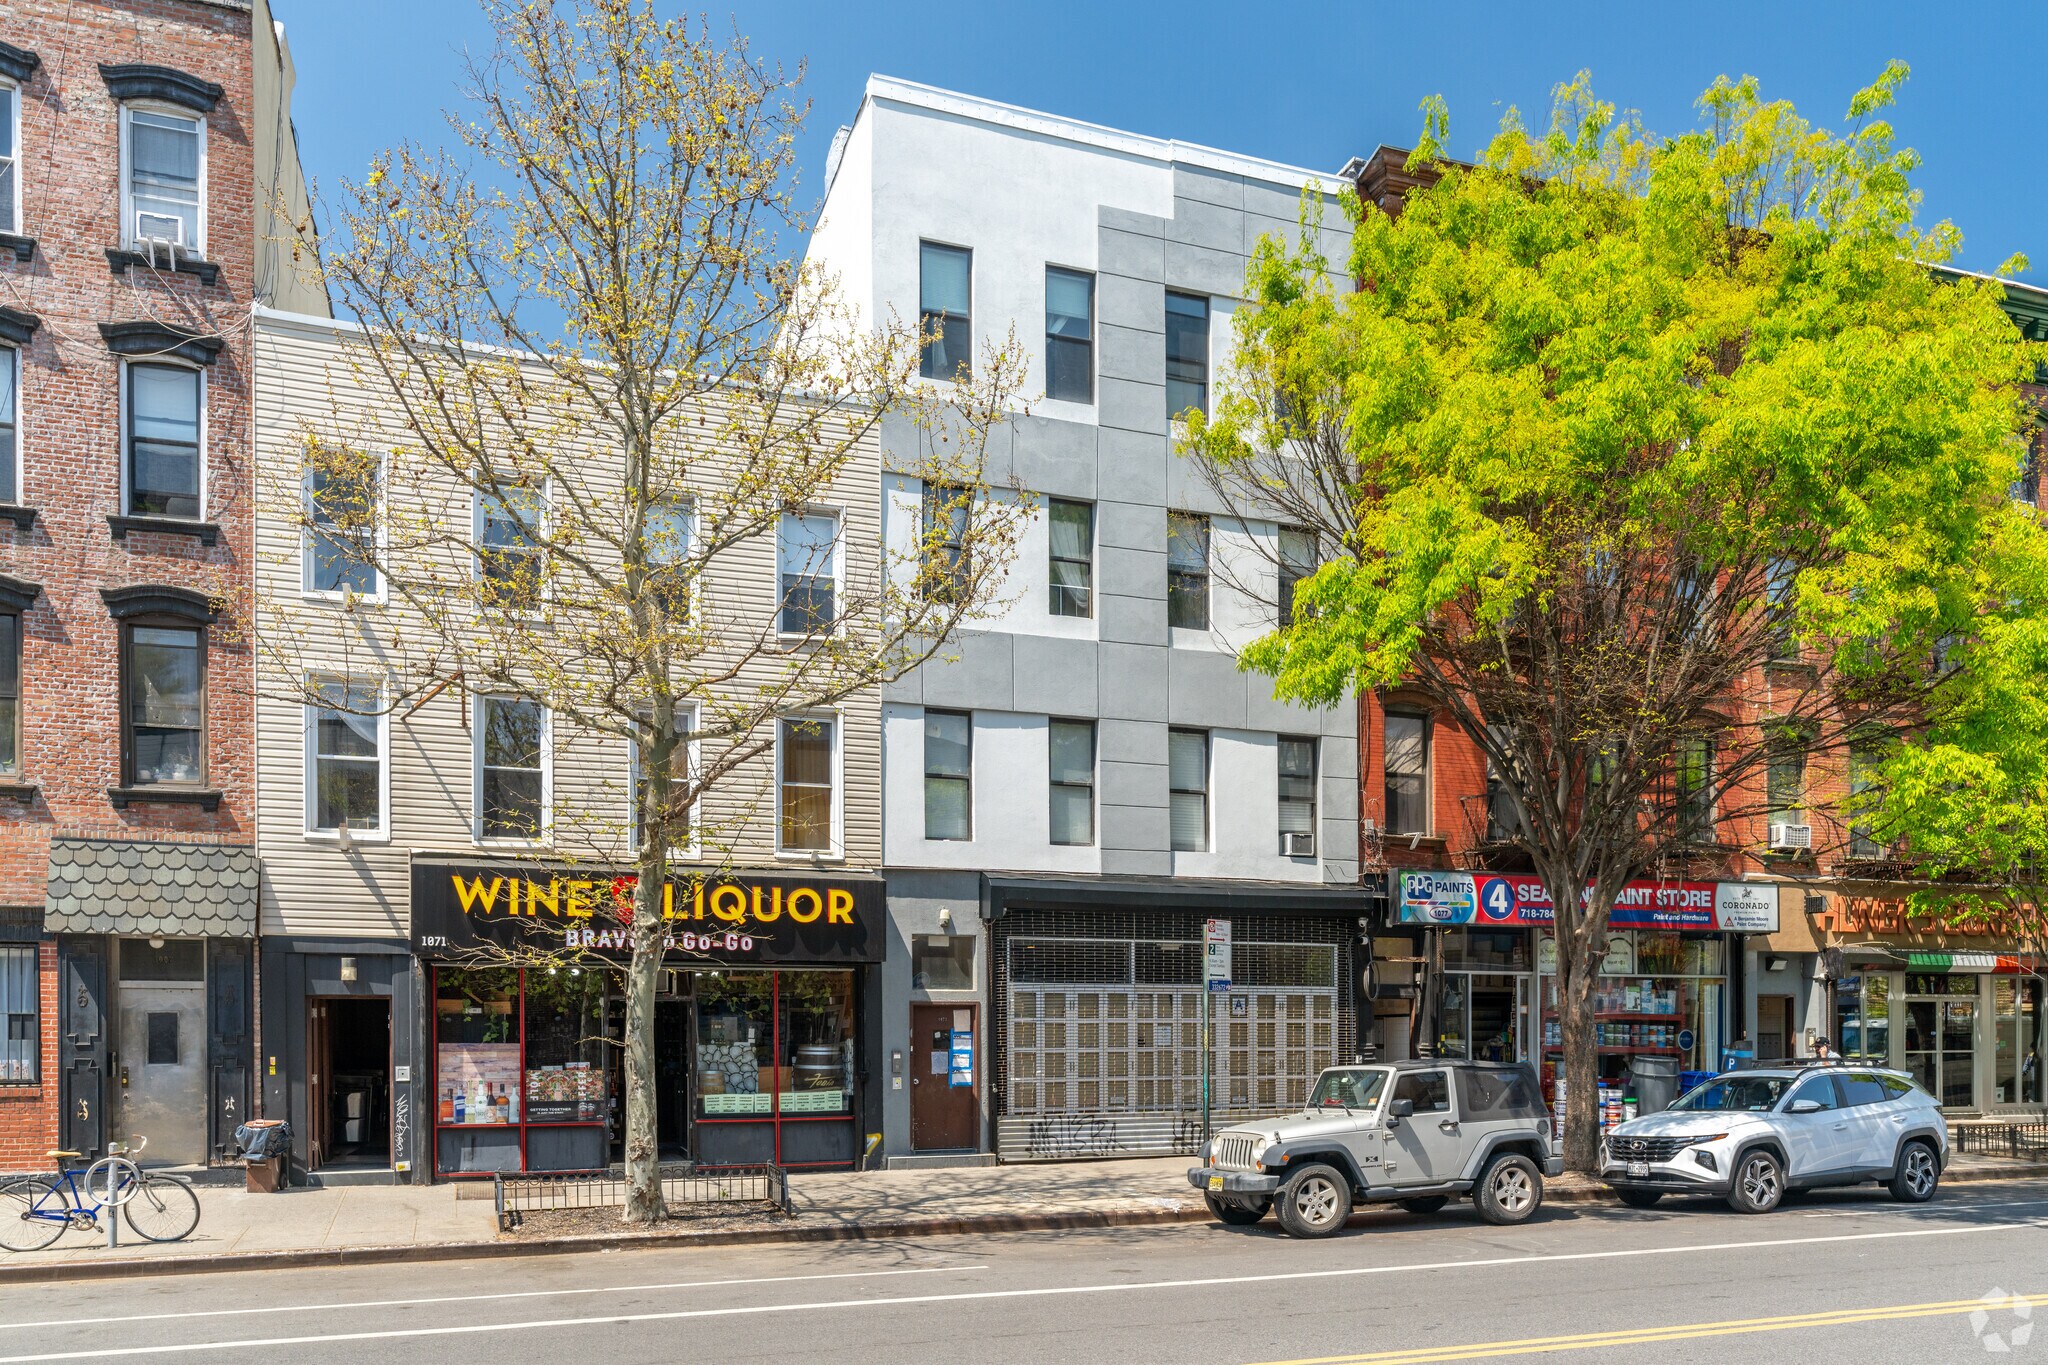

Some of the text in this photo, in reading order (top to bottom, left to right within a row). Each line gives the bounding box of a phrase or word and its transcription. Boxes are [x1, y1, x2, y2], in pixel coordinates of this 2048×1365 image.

[1407, 876, 1474, 895] PPG PAINTS
[452, 875, 854, 925] WINE LIQUOR
[1488, 883, 1508, 913] 4
[1613, 887, 1653, 905] AINT
[1656, 888, 1712, 907] STORE
[1722, 902, 1770, 910] CORONADO
[1434, 909, 1449, 917] 1077
[1681, 914, 1709, 922] Hardware
[421, 936, 447, 947] 1071
[683, 931, 753, 951] Go-Go
[1234, 1000, 1243, 1010] A
[1728, 1058, 1736, 1069] P
